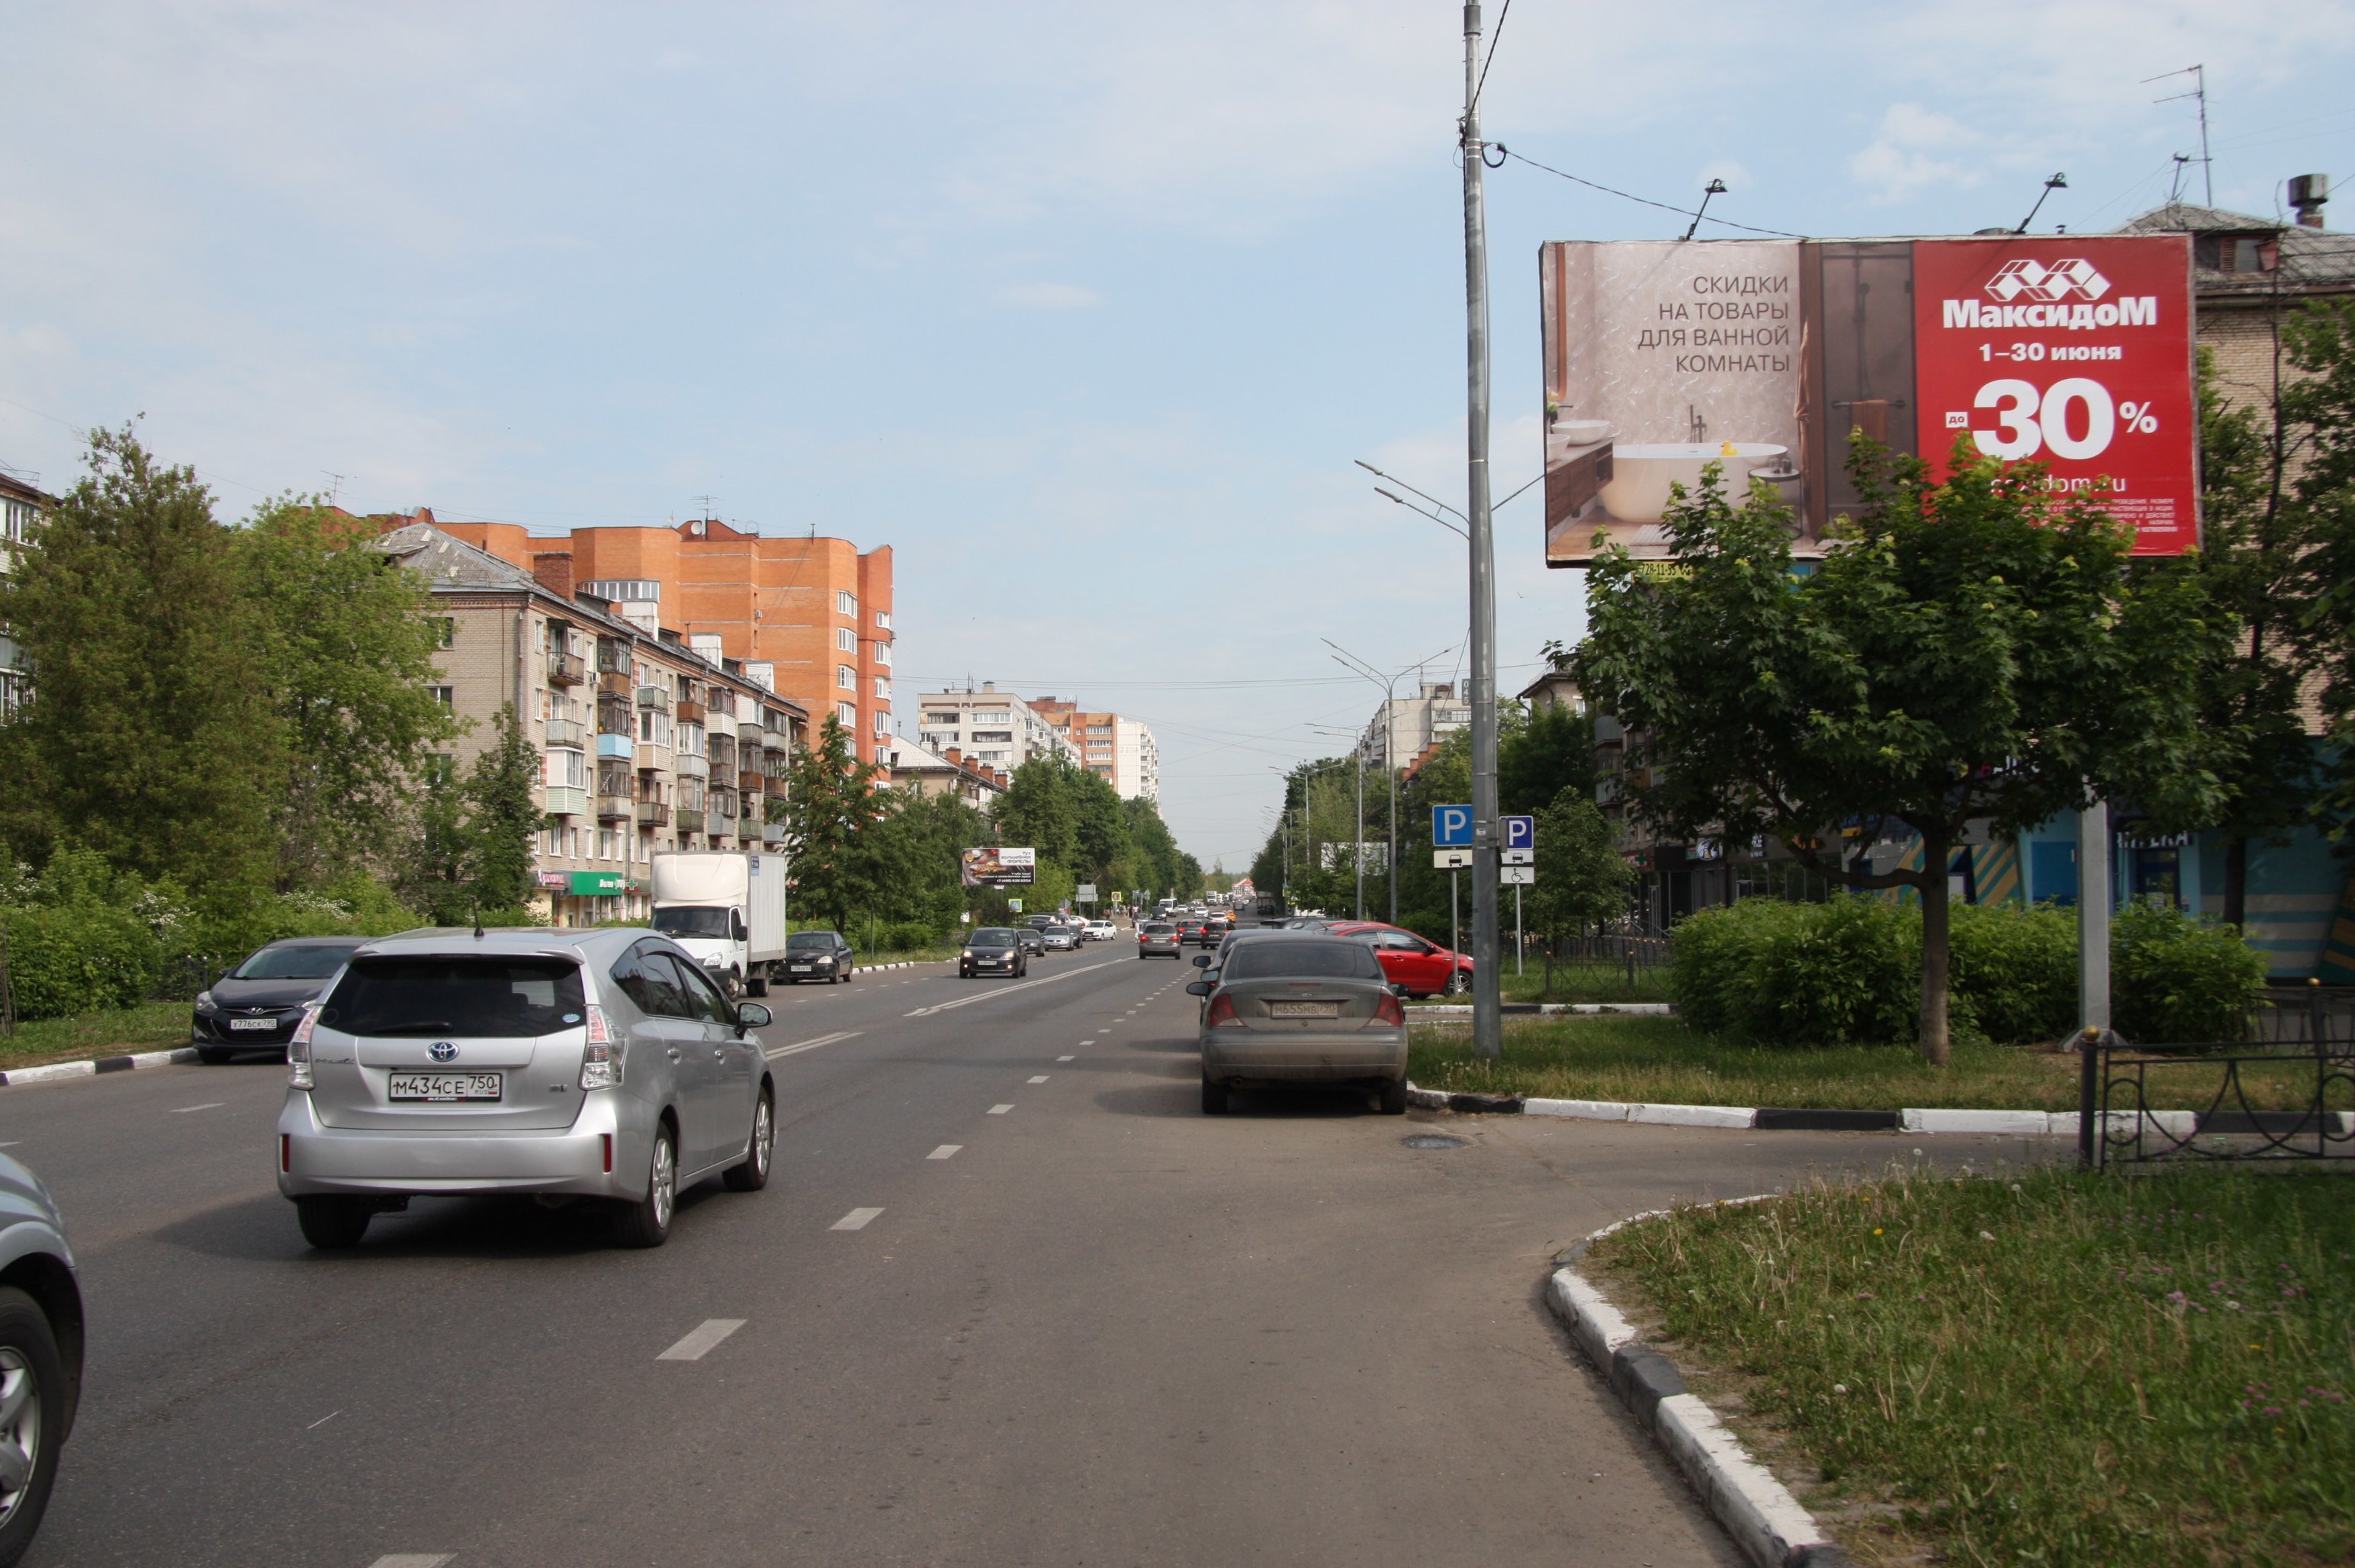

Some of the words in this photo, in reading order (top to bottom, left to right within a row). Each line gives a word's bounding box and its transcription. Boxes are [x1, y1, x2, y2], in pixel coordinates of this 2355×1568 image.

[1693, 276, 1788, 297] СКИДКИ
[1659, 303, 1689, 320] НА
[1694, 302, 1788, 320] ТОВАРЫ
[1942, 296, 2157, 330] МаксидоМ
[1637, 329, 1685, 350] ДЛЯ
[1693, 325, 1789, 346] ВАННОЙ
[2051, 345, 2122, 361] июня
[1676, 355, 1790, 373] КОМНАТЫ
[1949, 415, 1965, 425] до
[1444, 809, 1467, 841] P
[1508, 820, 1527, 846] P
